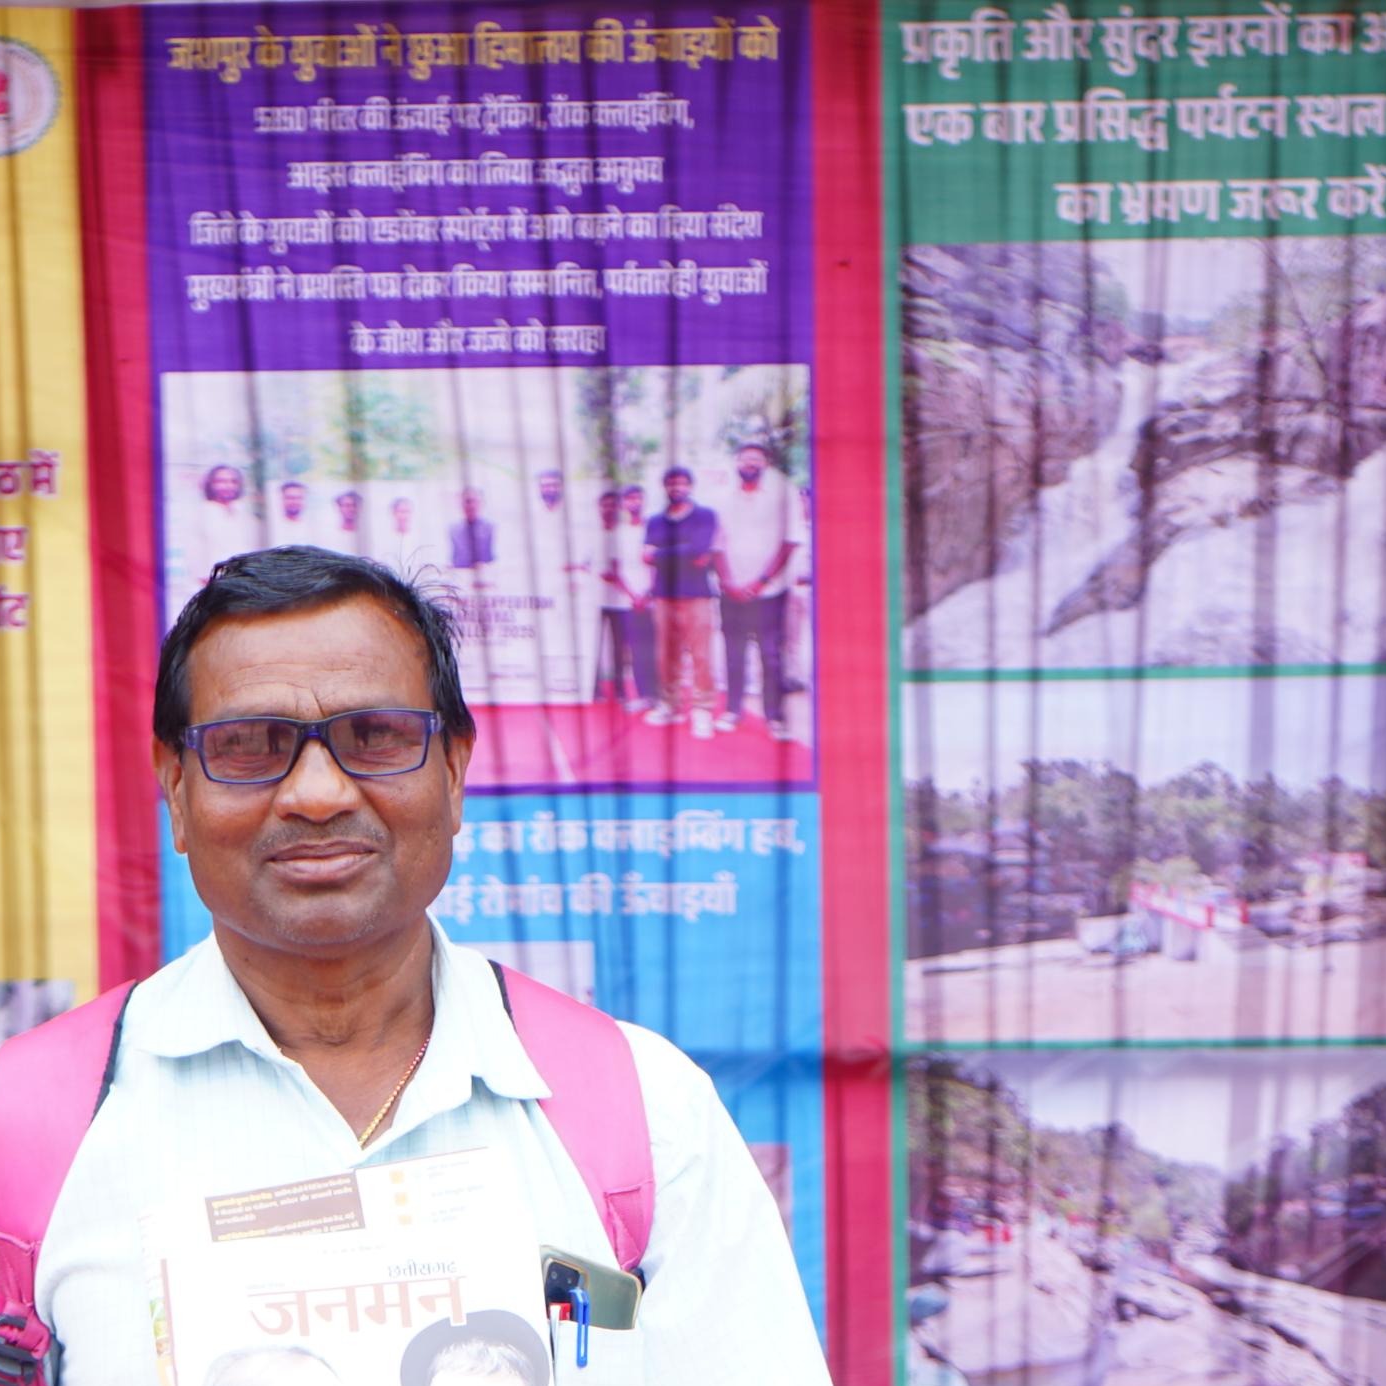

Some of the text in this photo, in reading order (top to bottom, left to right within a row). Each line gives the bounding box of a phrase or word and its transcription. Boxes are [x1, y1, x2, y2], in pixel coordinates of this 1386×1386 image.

[166, 36, 252, 83] जशपुर
[254, 25, 285, 66] के
[289, 24, 378, 82] युवाओं
[380, 23, 403, 66] ने
[407, 33, 471, 81] छुआ
[473, 21, 582, 70] हिमालय
[583, 18, 625, 64] की
[735, 15, 780, 62] को
[900, 10, 1014, 80] प्रकृति
[1023, 3, 1092, 61] और
[1098, 7, 1182, 76] सुंदर
[1187, 3, 1290, 67] झरनों
[1295, 14, 1355, 55] का
[309, 97, 358, 132] मीटर
[358, 96, 391, 131] की
[452, 103, 482, 129] पर
[902, 102, 976, 146] एक
[980, 102, 1045, 145] बार
[1052, 87, 1168, 151] प्रसिद्ध
[1175, 84, 1288, 140] पर्यटन
[445, 160, 478, 186] का
[479, 151, 533, 185] लिया
[596, 157, 664, 193] अनुभव
[1054, 182, 1111, 225] का
[1119, 180, 1220, 226] भ्रमण
[1226, 178, 1319, 221] जरूर
[188, 211, 238, 245] जिले
[239, 211, 263, 244] के
[266, 209, 334, 255] युवाओं
[335, 209, 367, 243] को
[507, 207, 527, 240] में
[625, 214, 658, 239] का
[659, 204, 707, 241] दिया
[276, 265, 296, 300] ने
[452, 262, 507, 297] किया
[698, 259, 769, 306] युवाओं
[348, 318, 607, 355] के जोश और को सराहा
[26, 450, 59, 496] में
[479, 820, 524, 853] का
[529, 811, 588, 854] रॉक
[565, 872, 614, 914] की
[246, 1276, 467, 1337] जनमन
